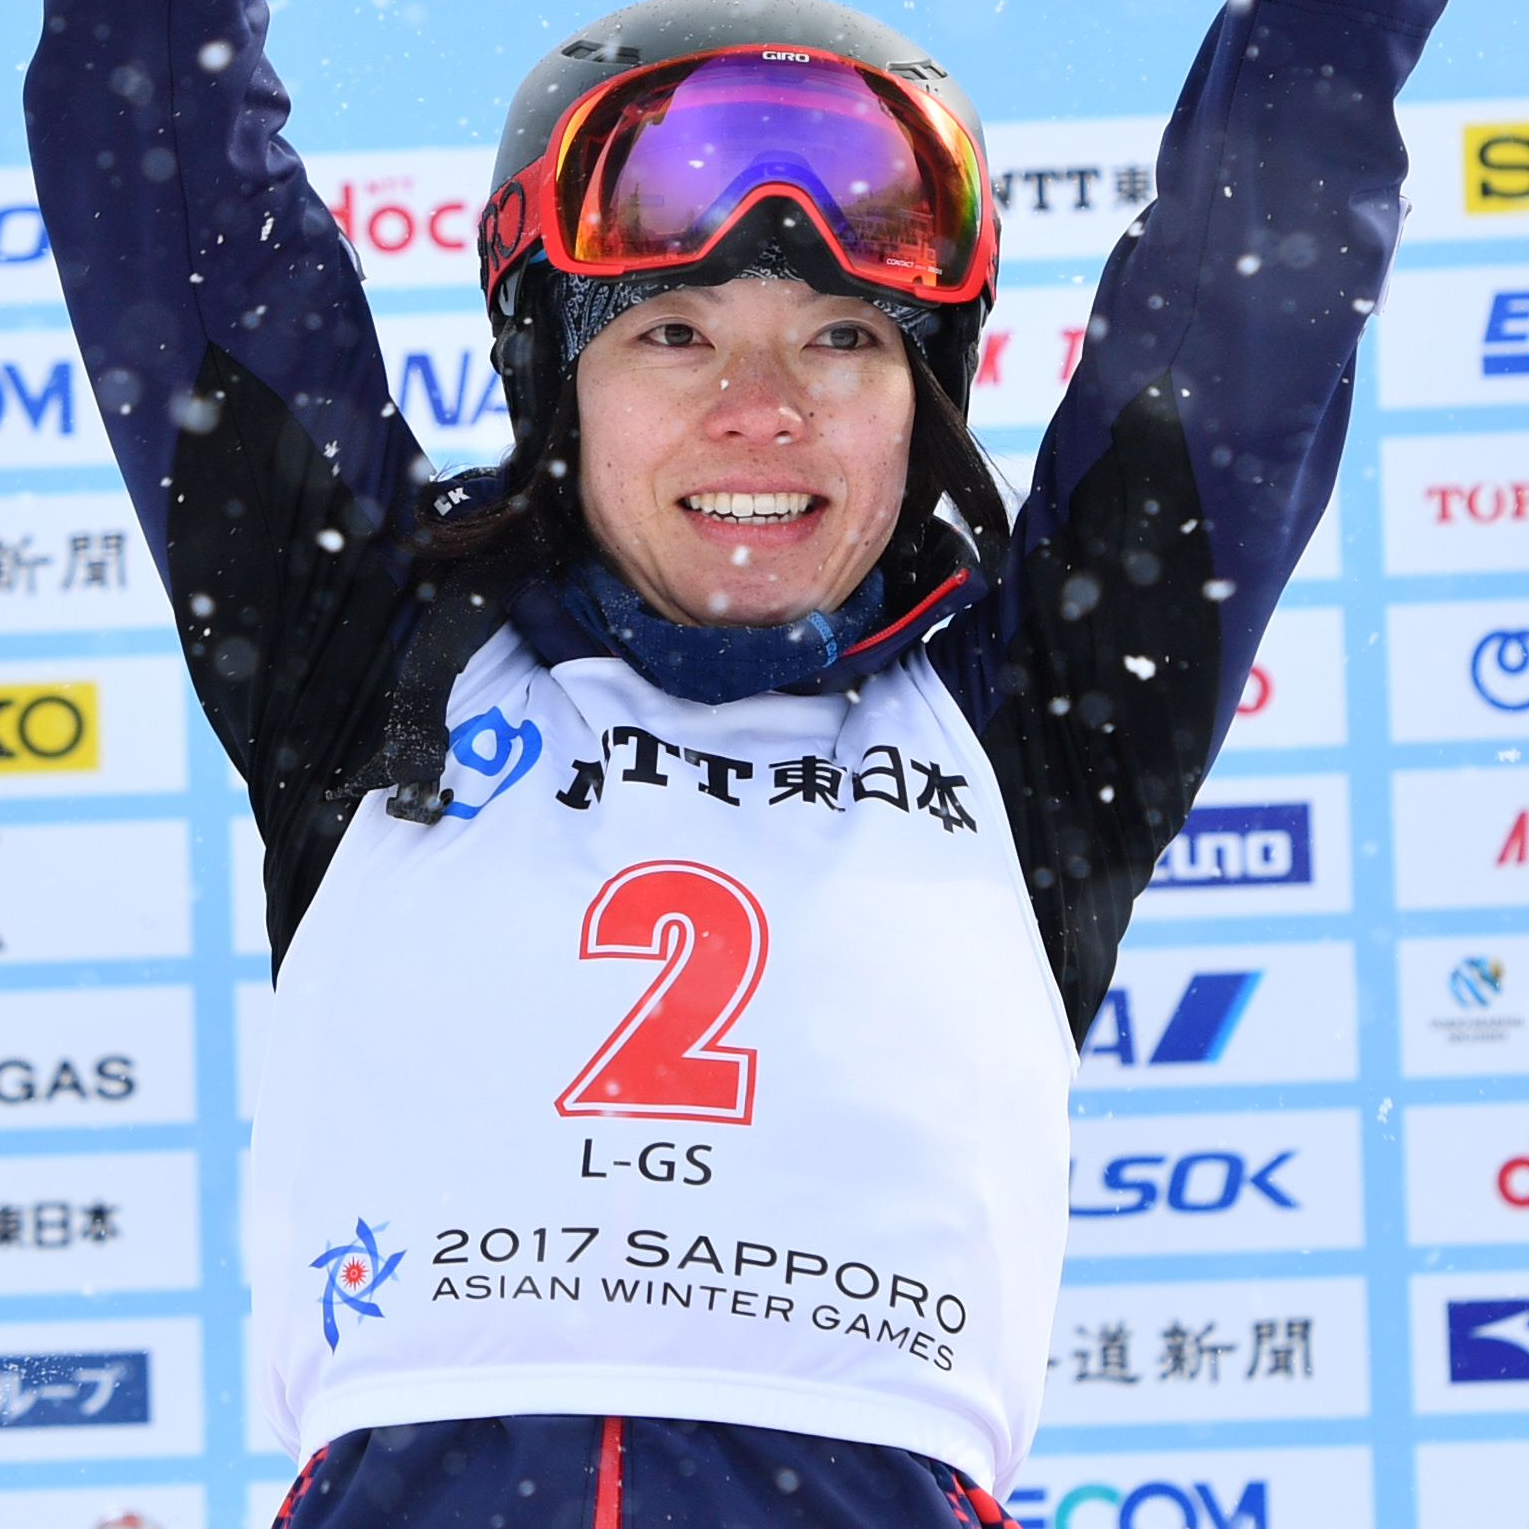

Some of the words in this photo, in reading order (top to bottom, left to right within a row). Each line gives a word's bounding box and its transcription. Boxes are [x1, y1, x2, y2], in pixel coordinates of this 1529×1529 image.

[762, 51, 810, 63] GIRO
[554, 725, 978, 835] NTT東日本
[552, 858, 770, 1127] 2
[581, 1138, 712, 1186] L-GS
[432, 1226, 600, 1265] 2017
[624, 1228, 968, 1336] SAPPORO
[432, 1275, 581, 1302] ASIAN
[600, 1277, 796, 1323] WINTER
[811, 1304, 954, 1373] GAMES
